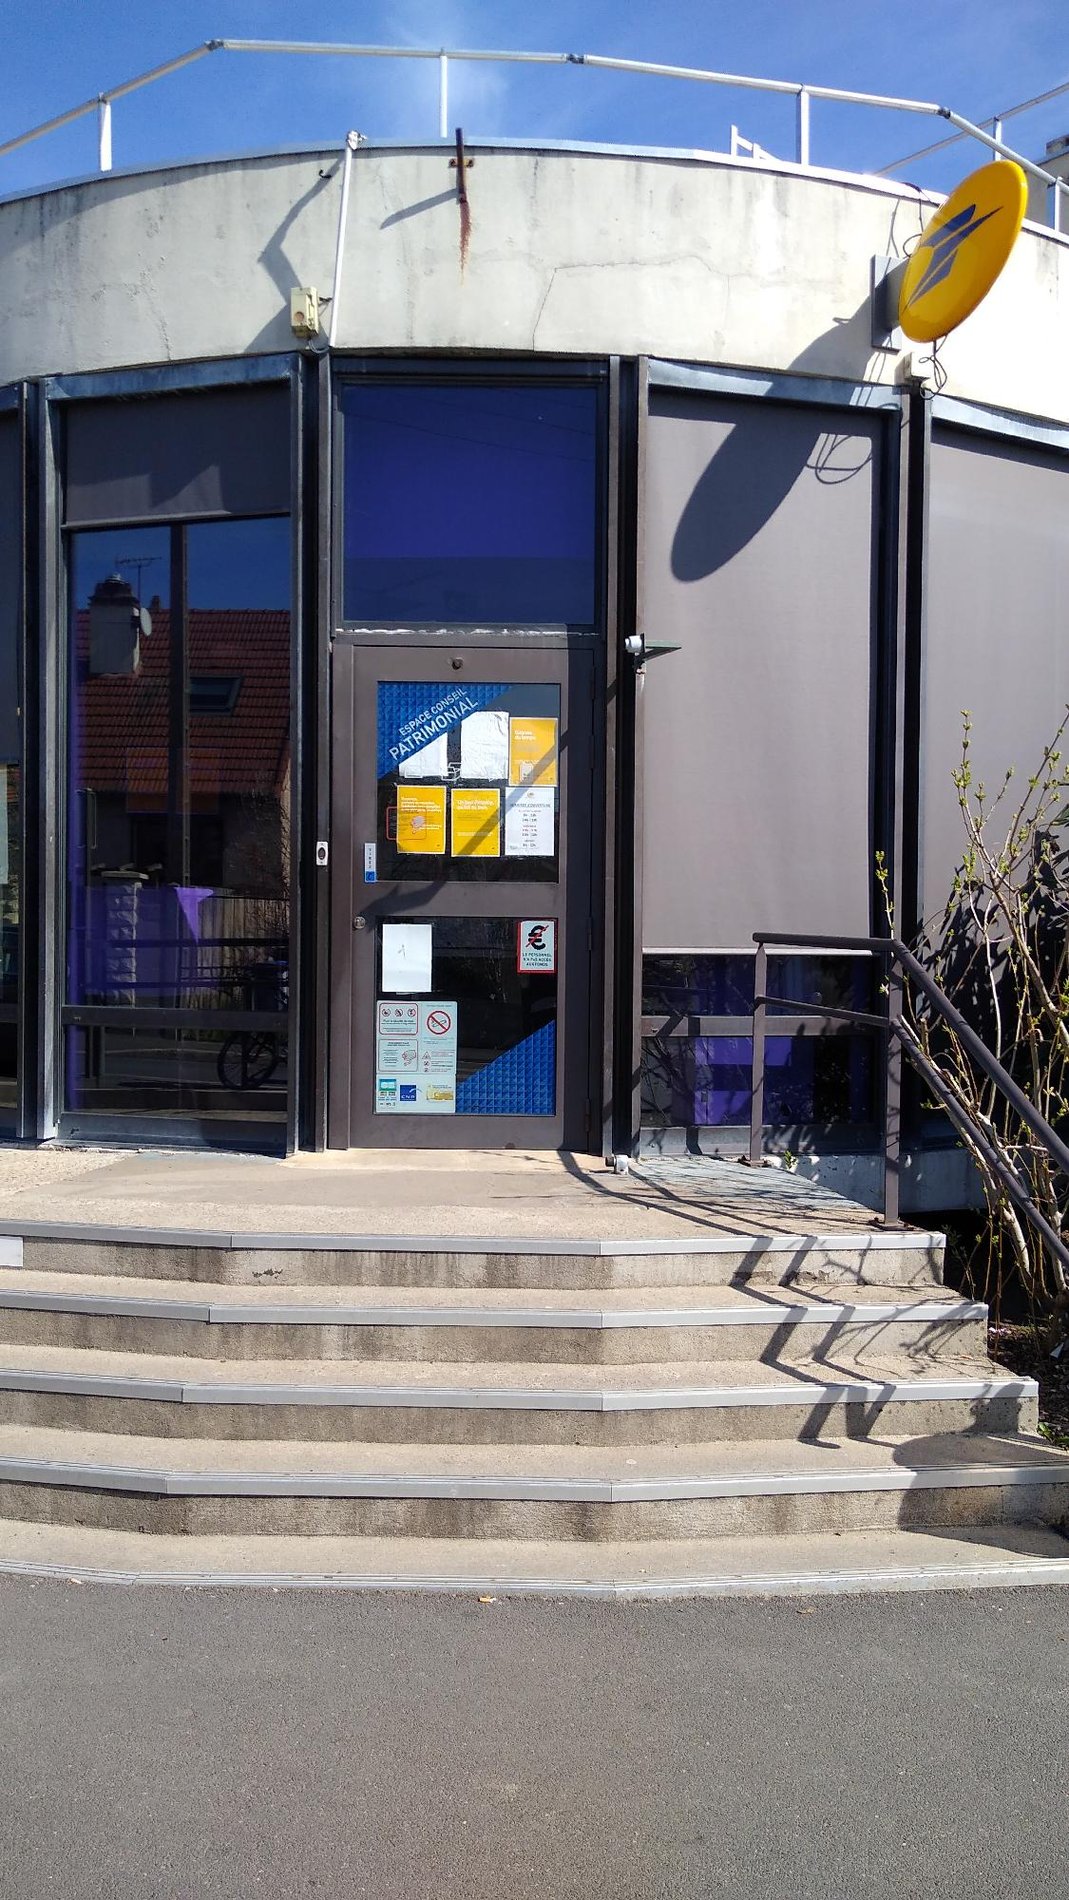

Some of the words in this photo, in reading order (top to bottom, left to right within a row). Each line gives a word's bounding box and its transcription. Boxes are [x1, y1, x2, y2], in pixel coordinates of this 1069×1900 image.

[388, 697, 479, 761] PATRIMONIAL
[398, 710, 432, 737] ESPACE
[432, 688, 468, 715] CONSEIL
